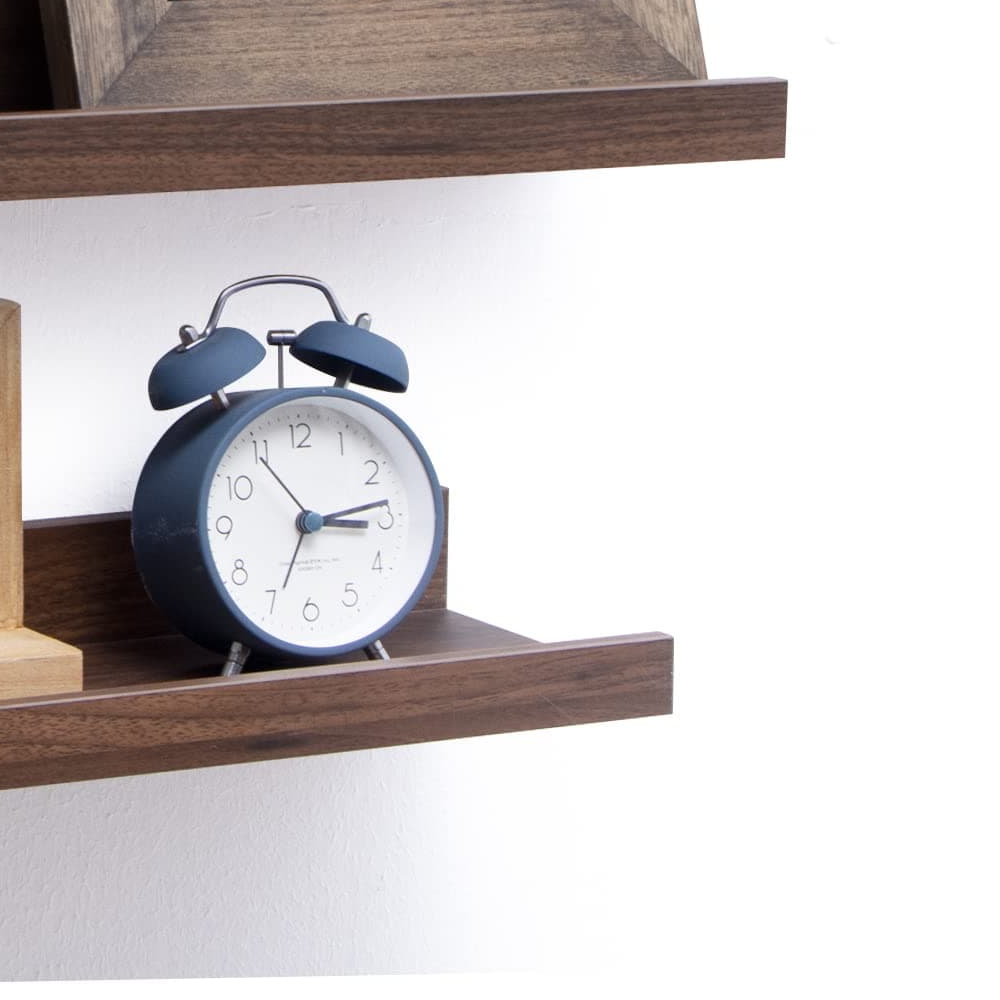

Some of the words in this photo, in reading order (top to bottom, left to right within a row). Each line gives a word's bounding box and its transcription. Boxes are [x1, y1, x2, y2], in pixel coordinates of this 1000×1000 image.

[289, 422, 312, 448] 12
[337, 431, 344, 456] 1
[252, 439, 269, 465] 11
[363, 459, 380, 485] 2
[227, 475, 253, 501] 10
[215, 515, 233, 541] 9
[377, 502, 394, 530] 3
[231, 558, 248, 586] 8
[371, 550, 383, 574] 4
[265, 589, 277, 615] 7
[341, 582, 359, 607] 5
[302, 597, 320, 622] 6
